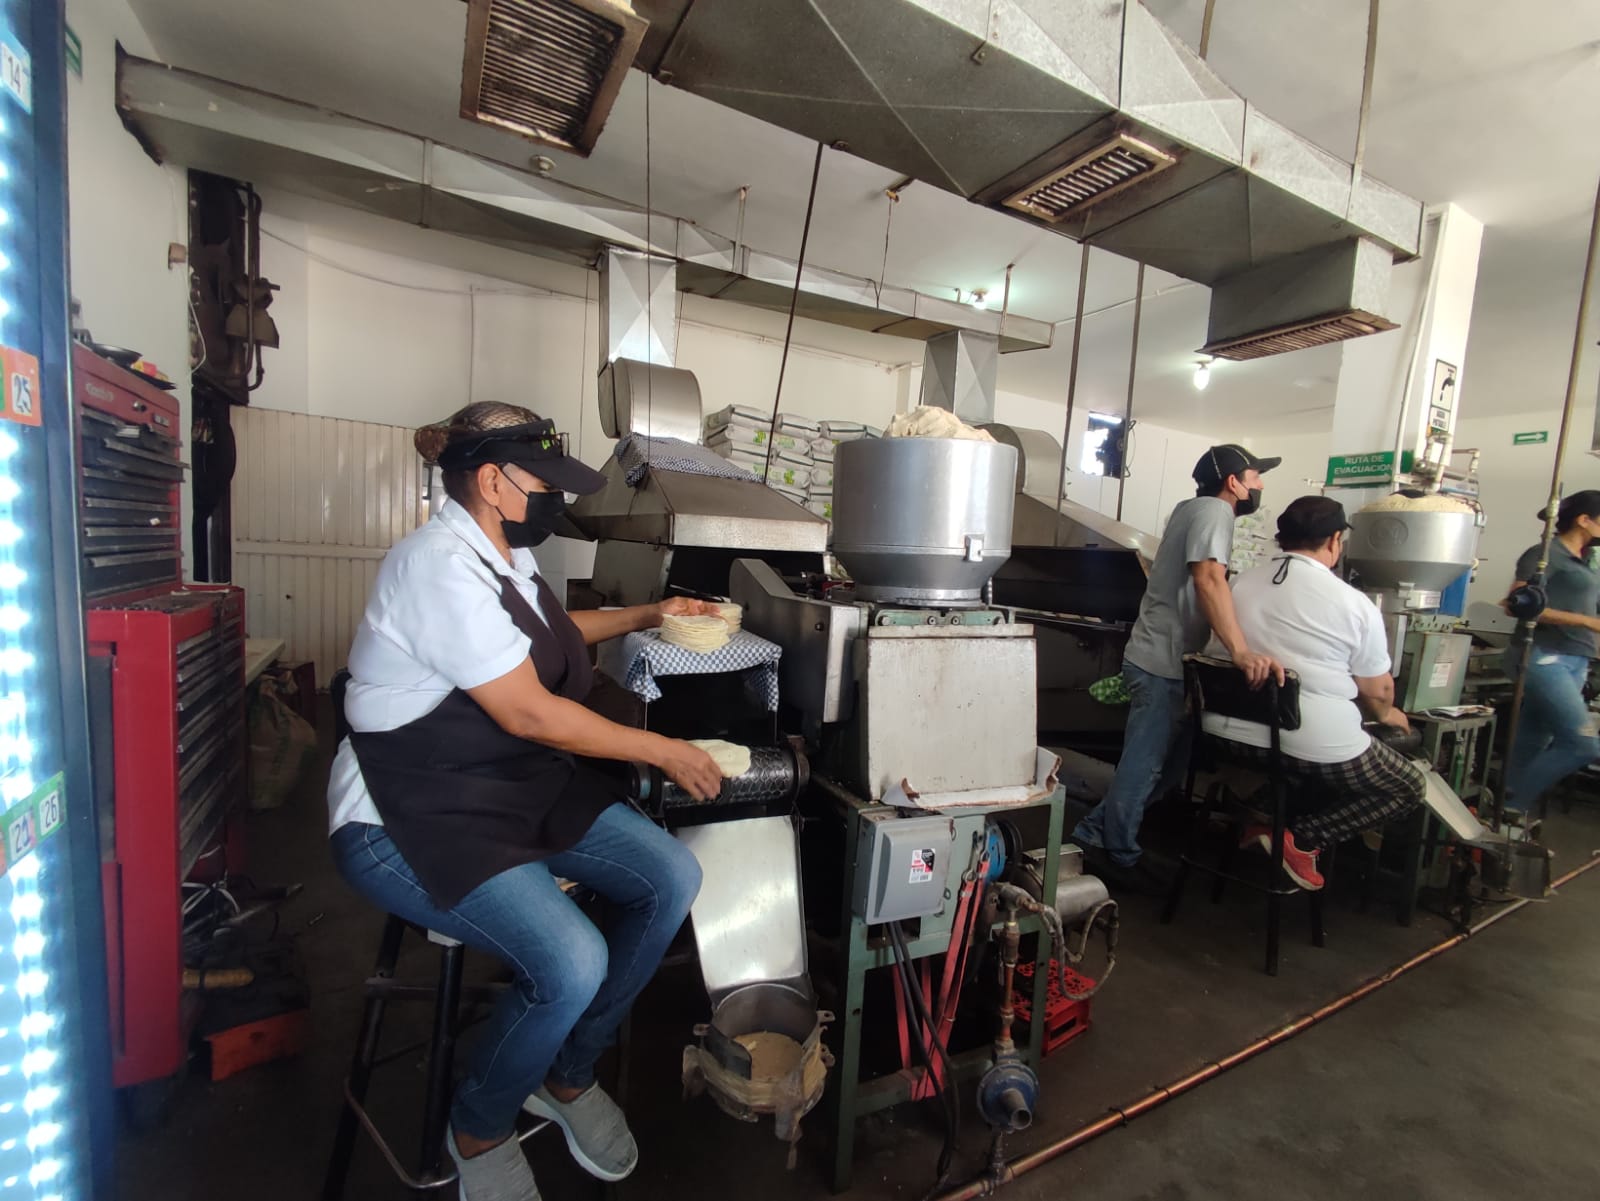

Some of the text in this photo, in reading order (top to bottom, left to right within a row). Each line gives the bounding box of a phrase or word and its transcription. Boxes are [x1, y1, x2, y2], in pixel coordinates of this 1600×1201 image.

[15, 374, 32, 413] 25
[1344, 454, 1385, 465] RUTA DE
[44, 795, 58, 828] 26
